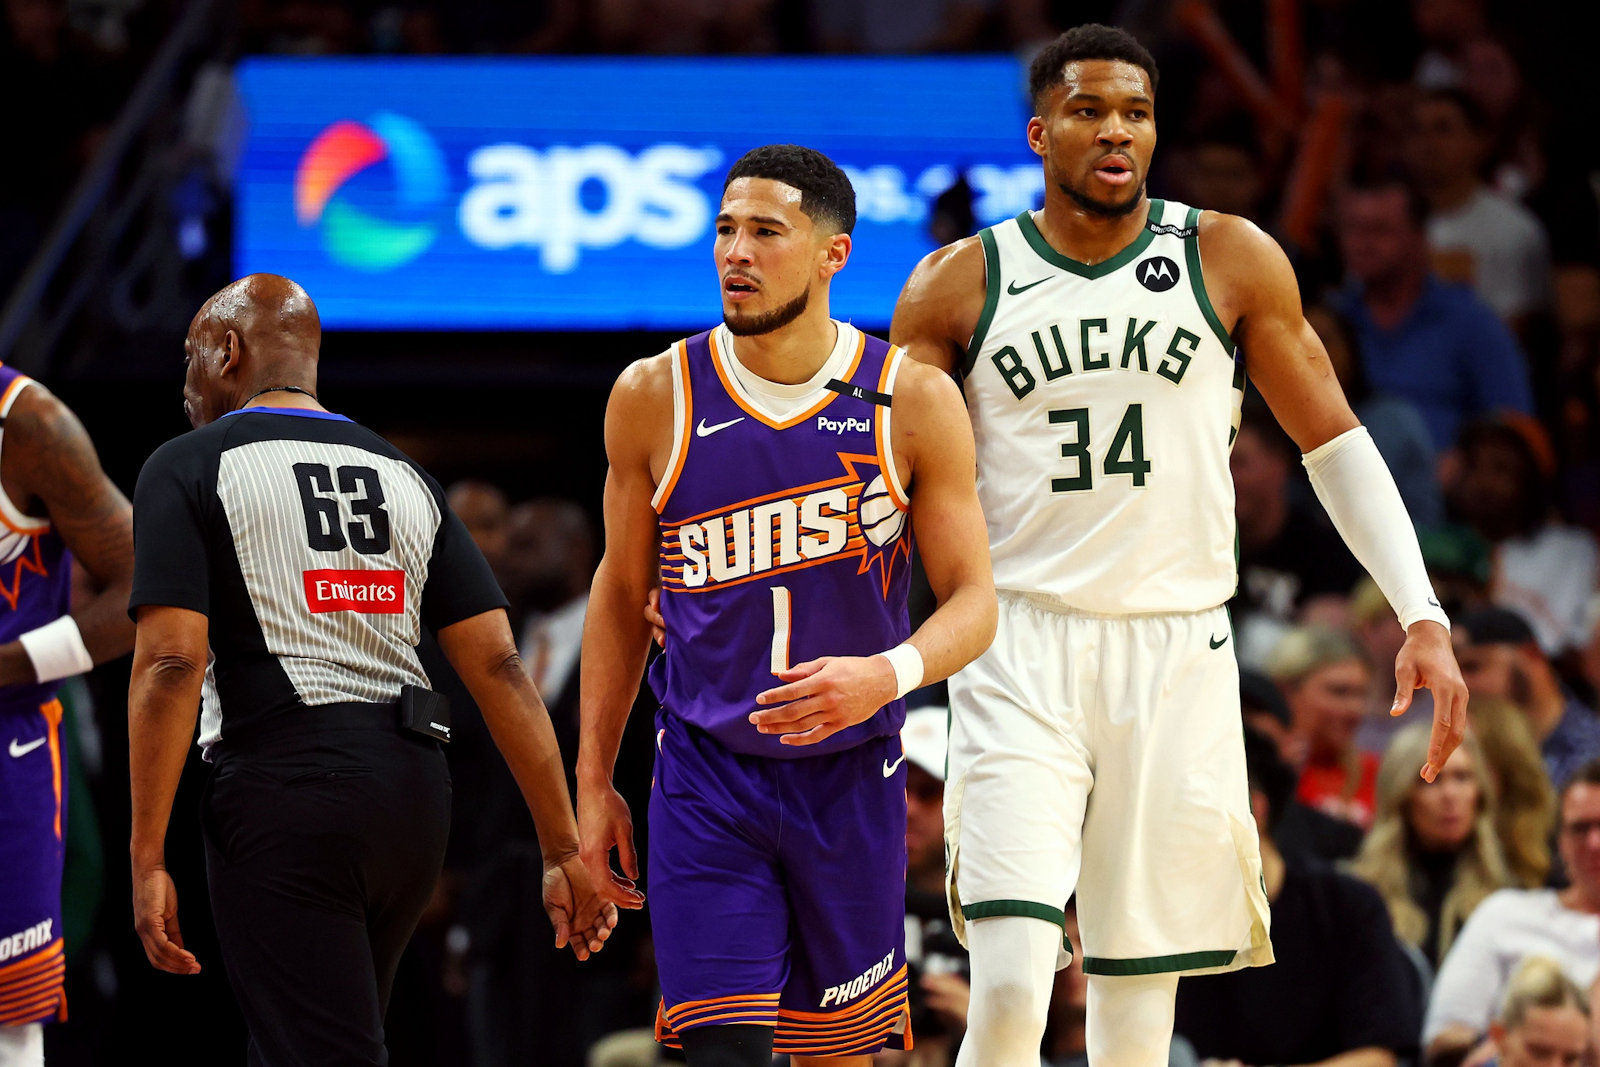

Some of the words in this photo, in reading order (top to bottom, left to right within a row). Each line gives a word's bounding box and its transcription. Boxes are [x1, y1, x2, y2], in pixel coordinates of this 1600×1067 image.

[457, 142, 711, 275] aps
[1150, 224, 1192, 237] BRIDGEMAN
[852, 387, 863, 399] AL
[991, 317, 1202, 401] BUCKS
[817, 416, 871, 435] PayPal
[1048, 403, 1151, 493] 34
[292, 462, 391, 555] 63
[679, 488, 848, 588] SUNS
[315, 579, 397, 602] Emirates
[770, 586, 792, 676] 1
[819, 947, 895, 1008] PHOENIX
